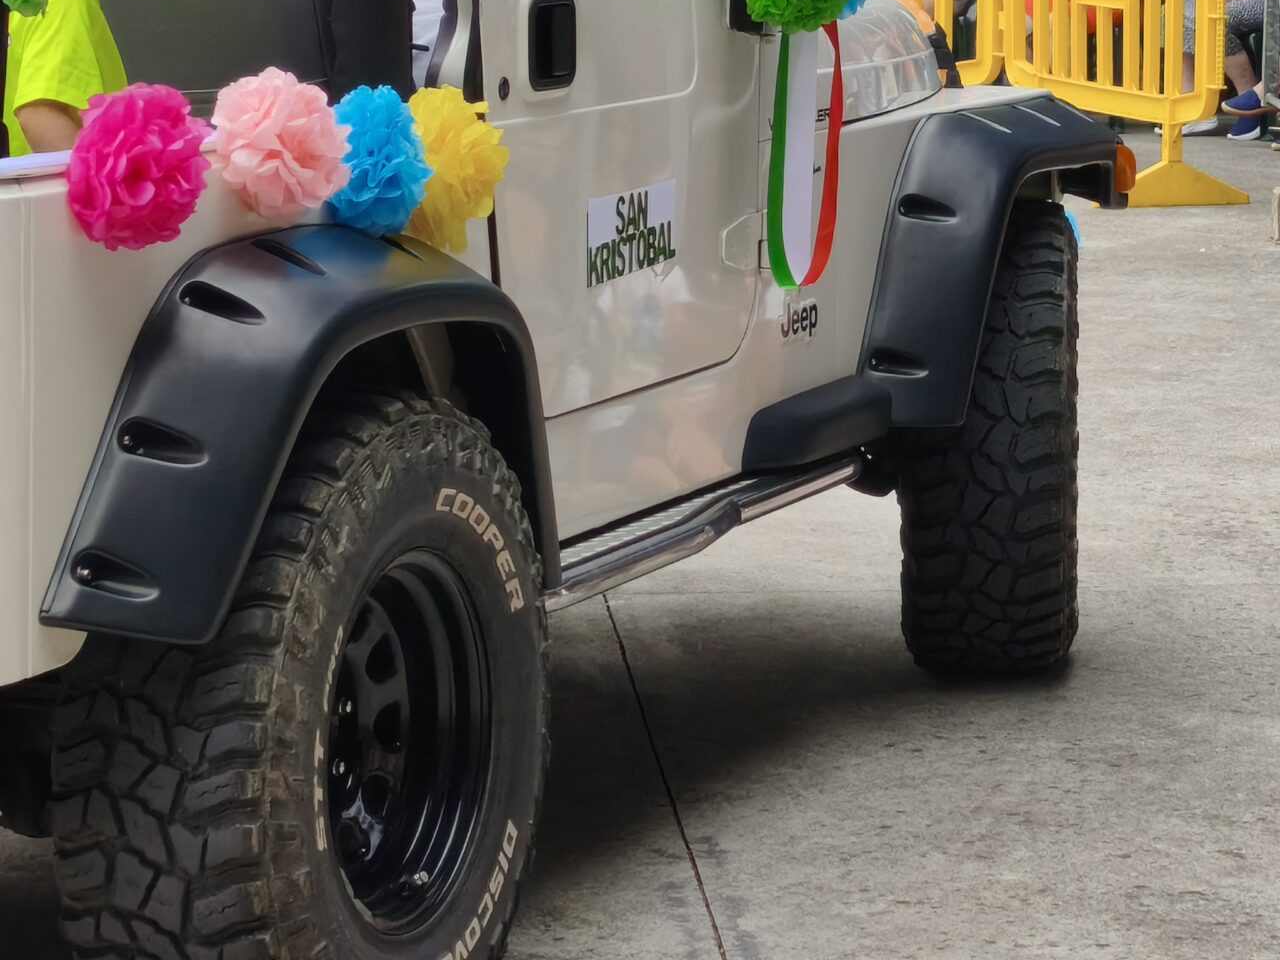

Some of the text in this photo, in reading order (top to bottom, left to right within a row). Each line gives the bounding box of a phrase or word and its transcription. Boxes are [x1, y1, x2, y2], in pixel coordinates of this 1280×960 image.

[615, 190, 649, 235] SAN
[588, 220, 676, 288] KRISTOBAL
[780, 296, 819, 338] Jeep
[435, 487, 525, 613] COOPER
